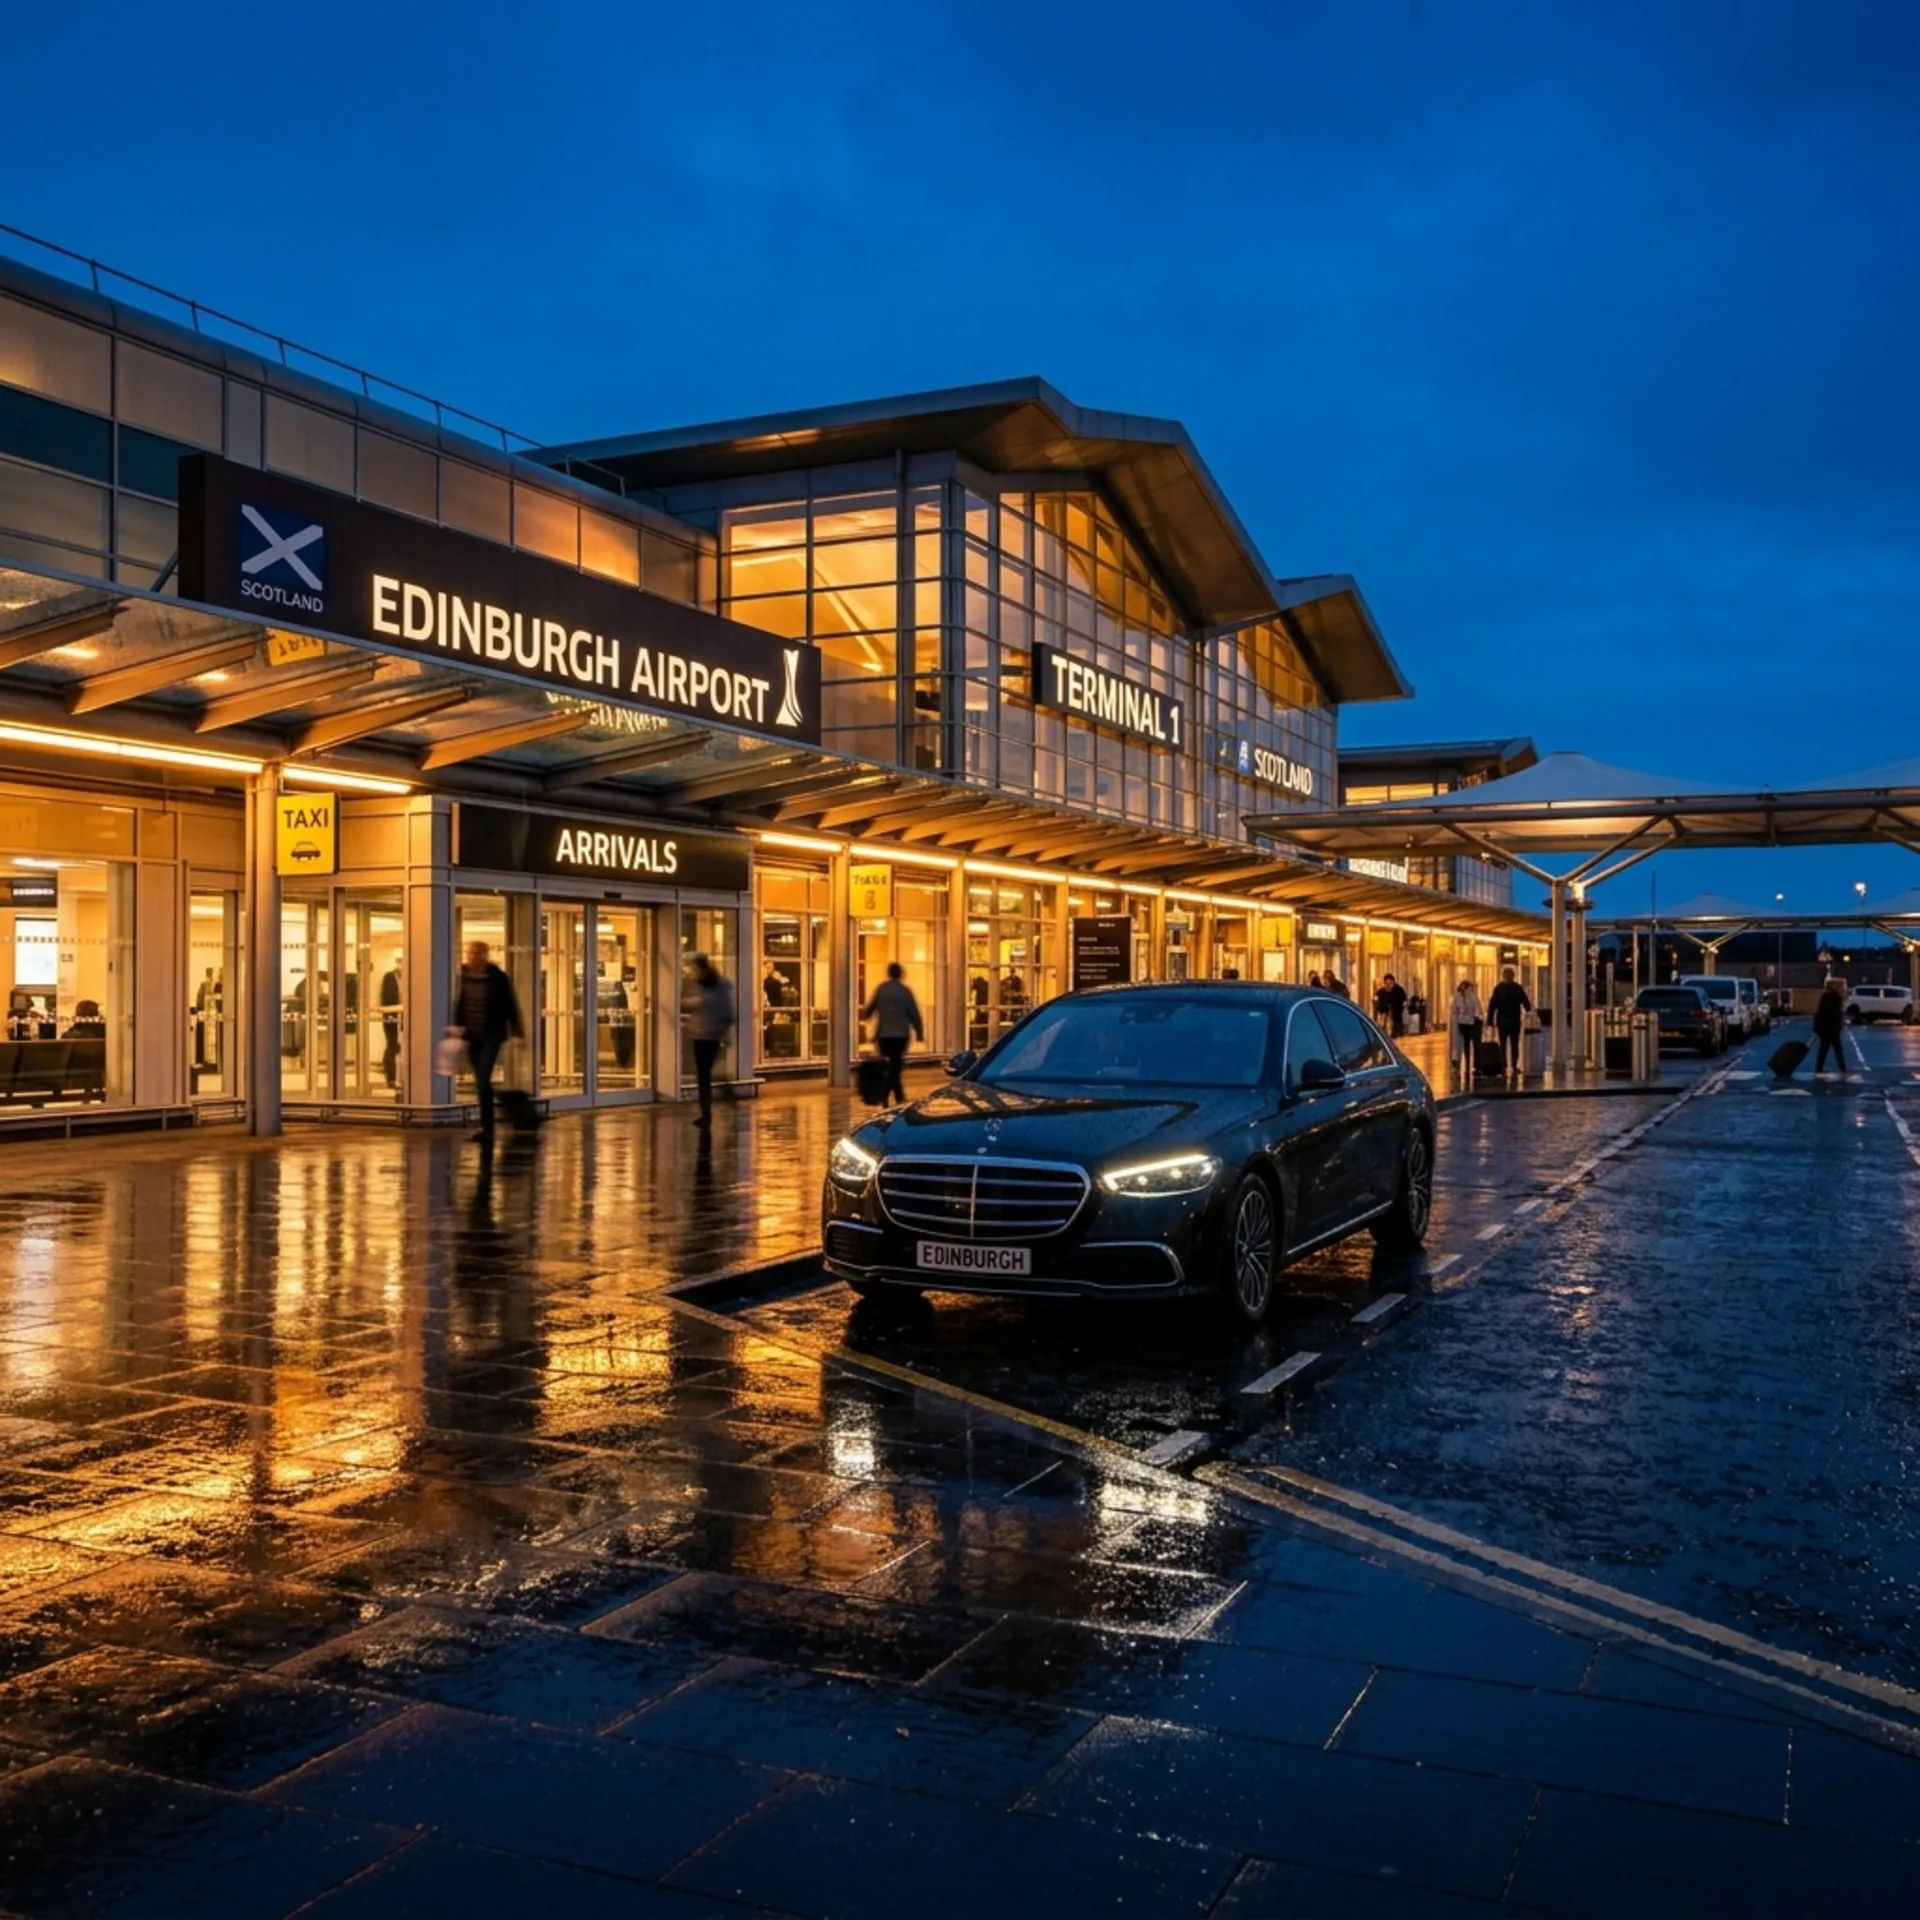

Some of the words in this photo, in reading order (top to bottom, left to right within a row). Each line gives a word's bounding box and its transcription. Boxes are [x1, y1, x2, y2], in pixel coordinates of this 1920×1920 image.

[241, 579, 324, 613] SCOTLAND
[372, 574, 620, 689] EDINBURGH
[630, 648, 770, 723] AIRPORT
[1051, 654, 1166, 741] TERMINAL
[1169, 705, 1180, 745] 1
[1254, 748, 1313, 796] SCOTLAND
[283, 807, 329, 829] TAXI
[556, 829, 678, 874] ARRIVALS
[923, 1244, 1024, 1270] EDINBURGH
